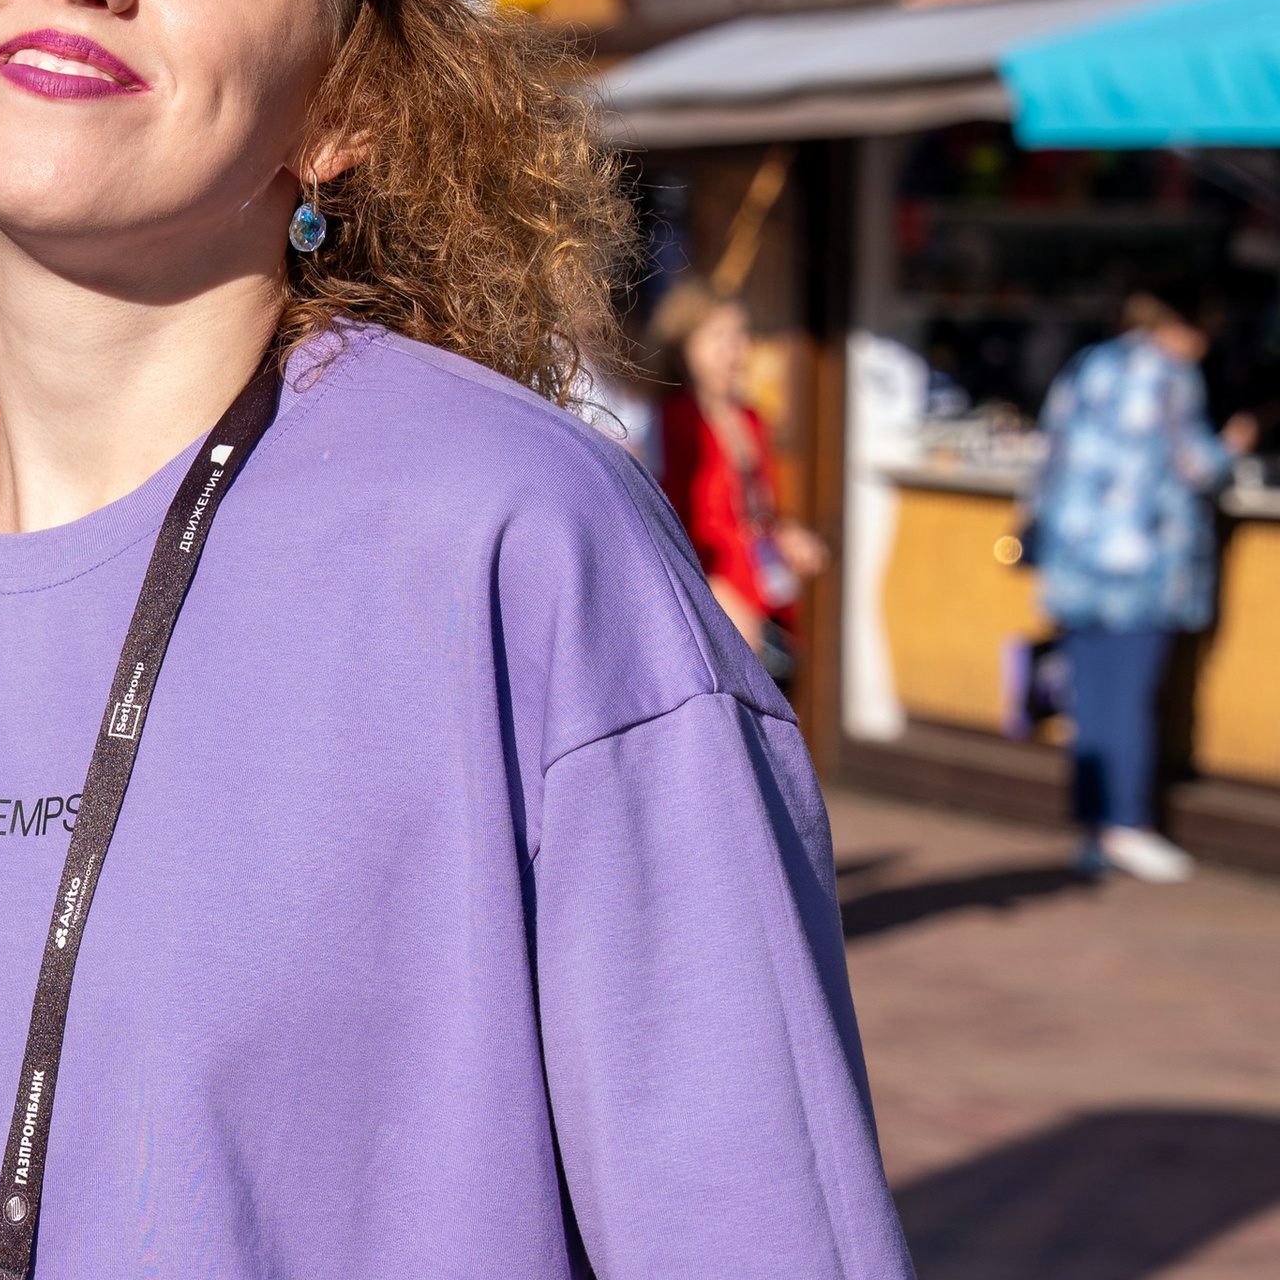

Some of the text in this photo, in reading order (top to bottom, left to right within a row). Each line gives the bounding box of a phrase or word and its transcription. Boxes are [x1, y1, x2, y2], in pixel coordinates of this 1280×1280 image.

[179, 469, 224, 553] ДВИЖЕНИЕ
[60, 876, 81, 928] Avito
[16, 1070, 45, 1185] ГАЗПРОМБАНК
